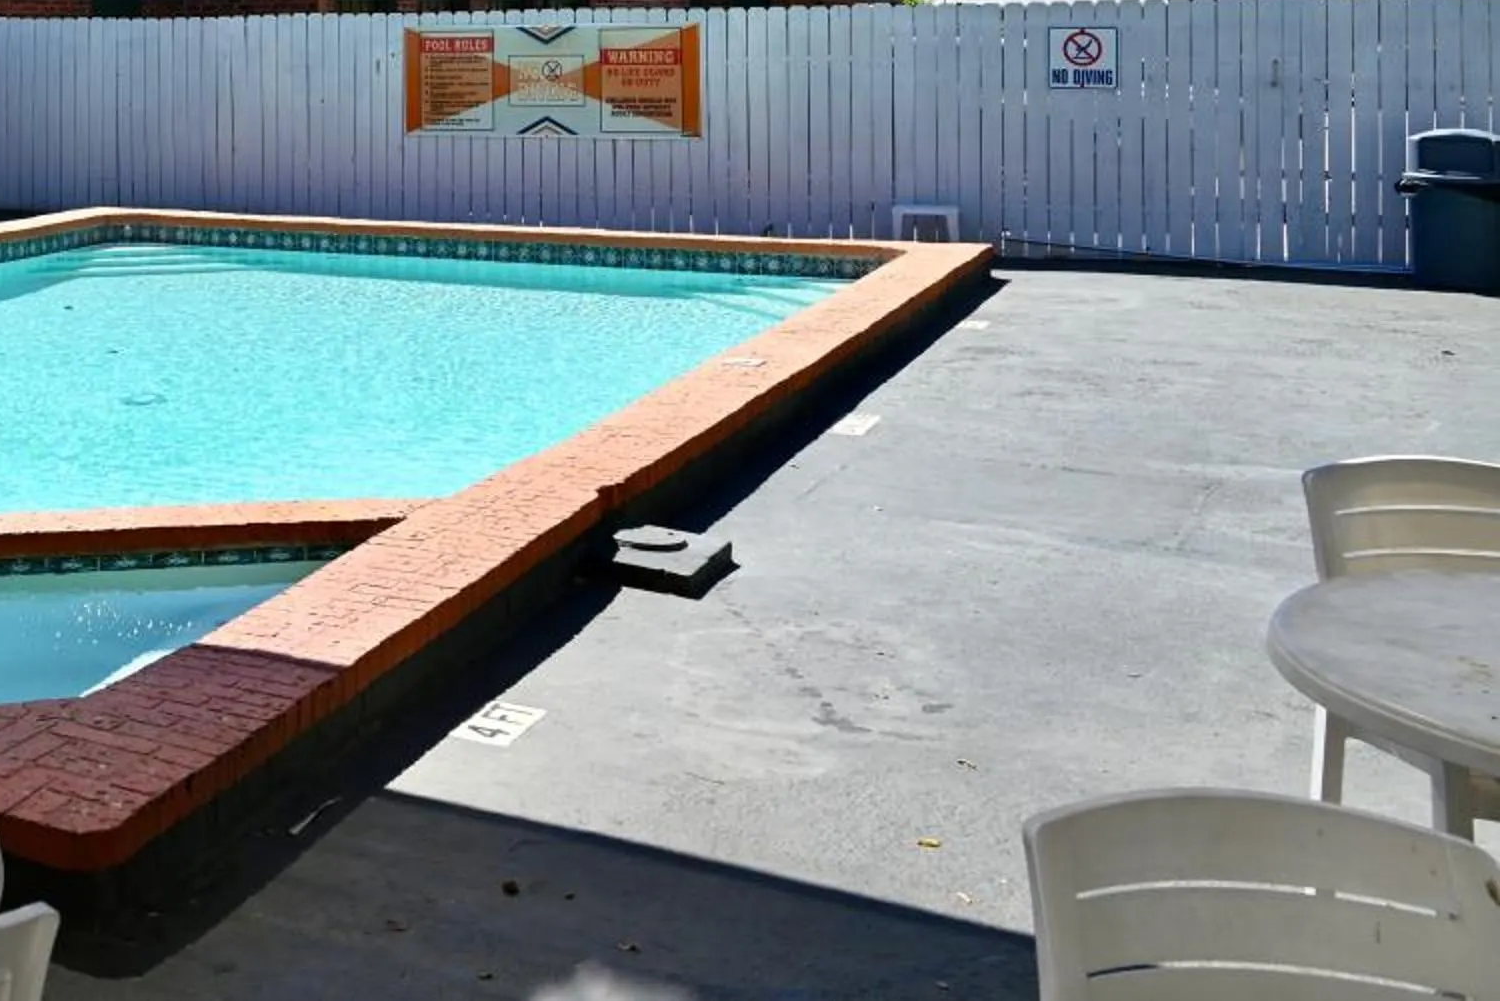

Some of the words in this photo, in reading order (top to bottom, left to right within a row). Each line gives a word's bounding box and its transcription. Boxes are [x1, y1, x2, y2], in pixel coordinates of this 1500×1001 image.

[607, 50, 674, 64] WARNING
[1051, 69, 1069, 85] NO
[1073, 69, 1113, 86] DIVING
